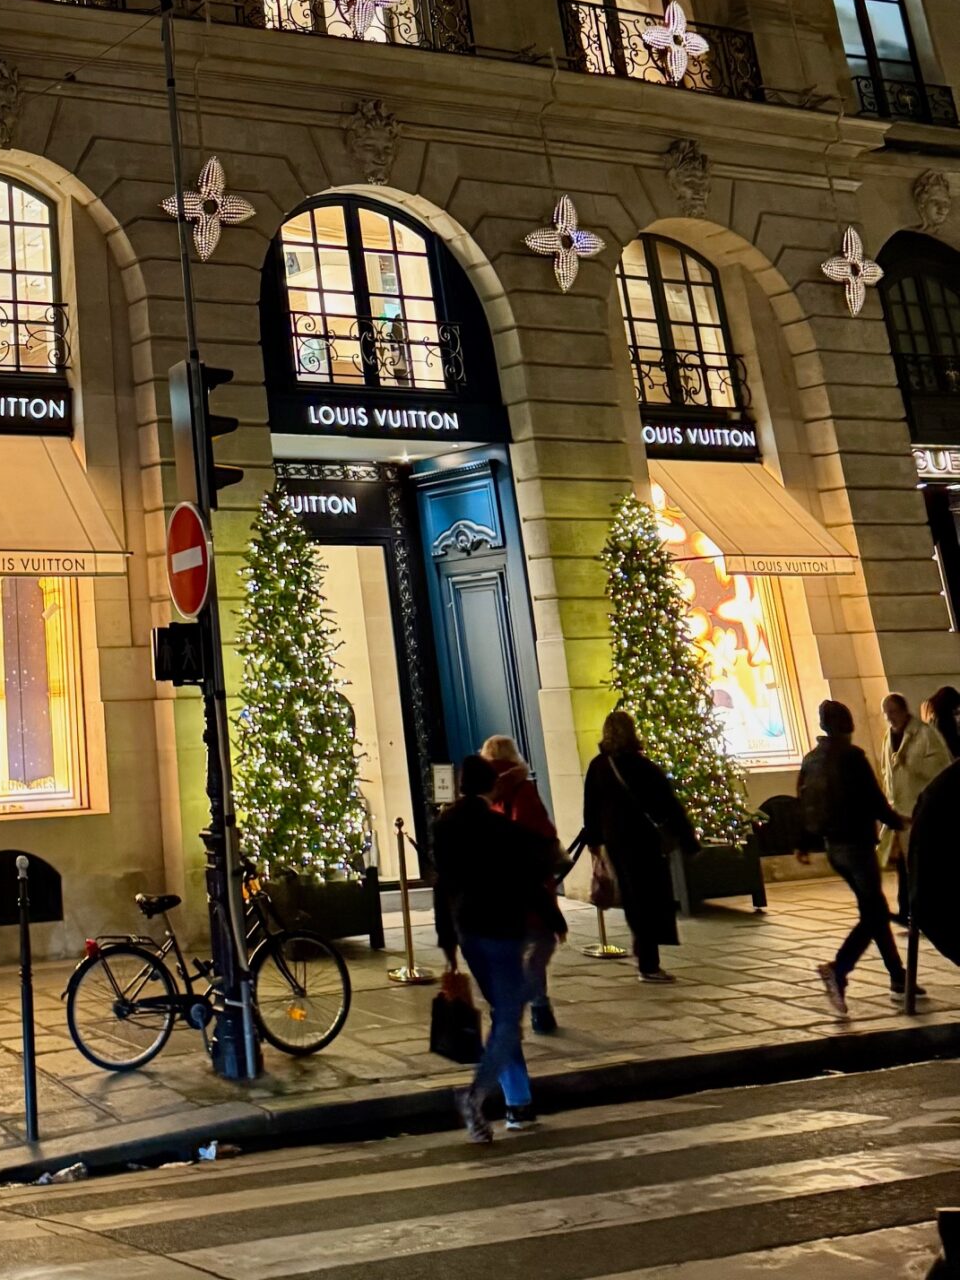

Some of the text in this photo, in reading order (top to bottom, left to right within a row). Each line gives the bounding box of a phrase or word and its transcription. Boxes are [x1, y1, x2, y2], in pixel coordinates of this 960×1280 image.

[308, 405, 459, 430] LOUIS VUITTON
[642, 425, 756, 447] OUIS VUITTON
[282, 494, 357, 515] UITTON
[20, 558, 85, 572] VUITTON
[752, 559, 829, 573] LOUIS VUITTON
